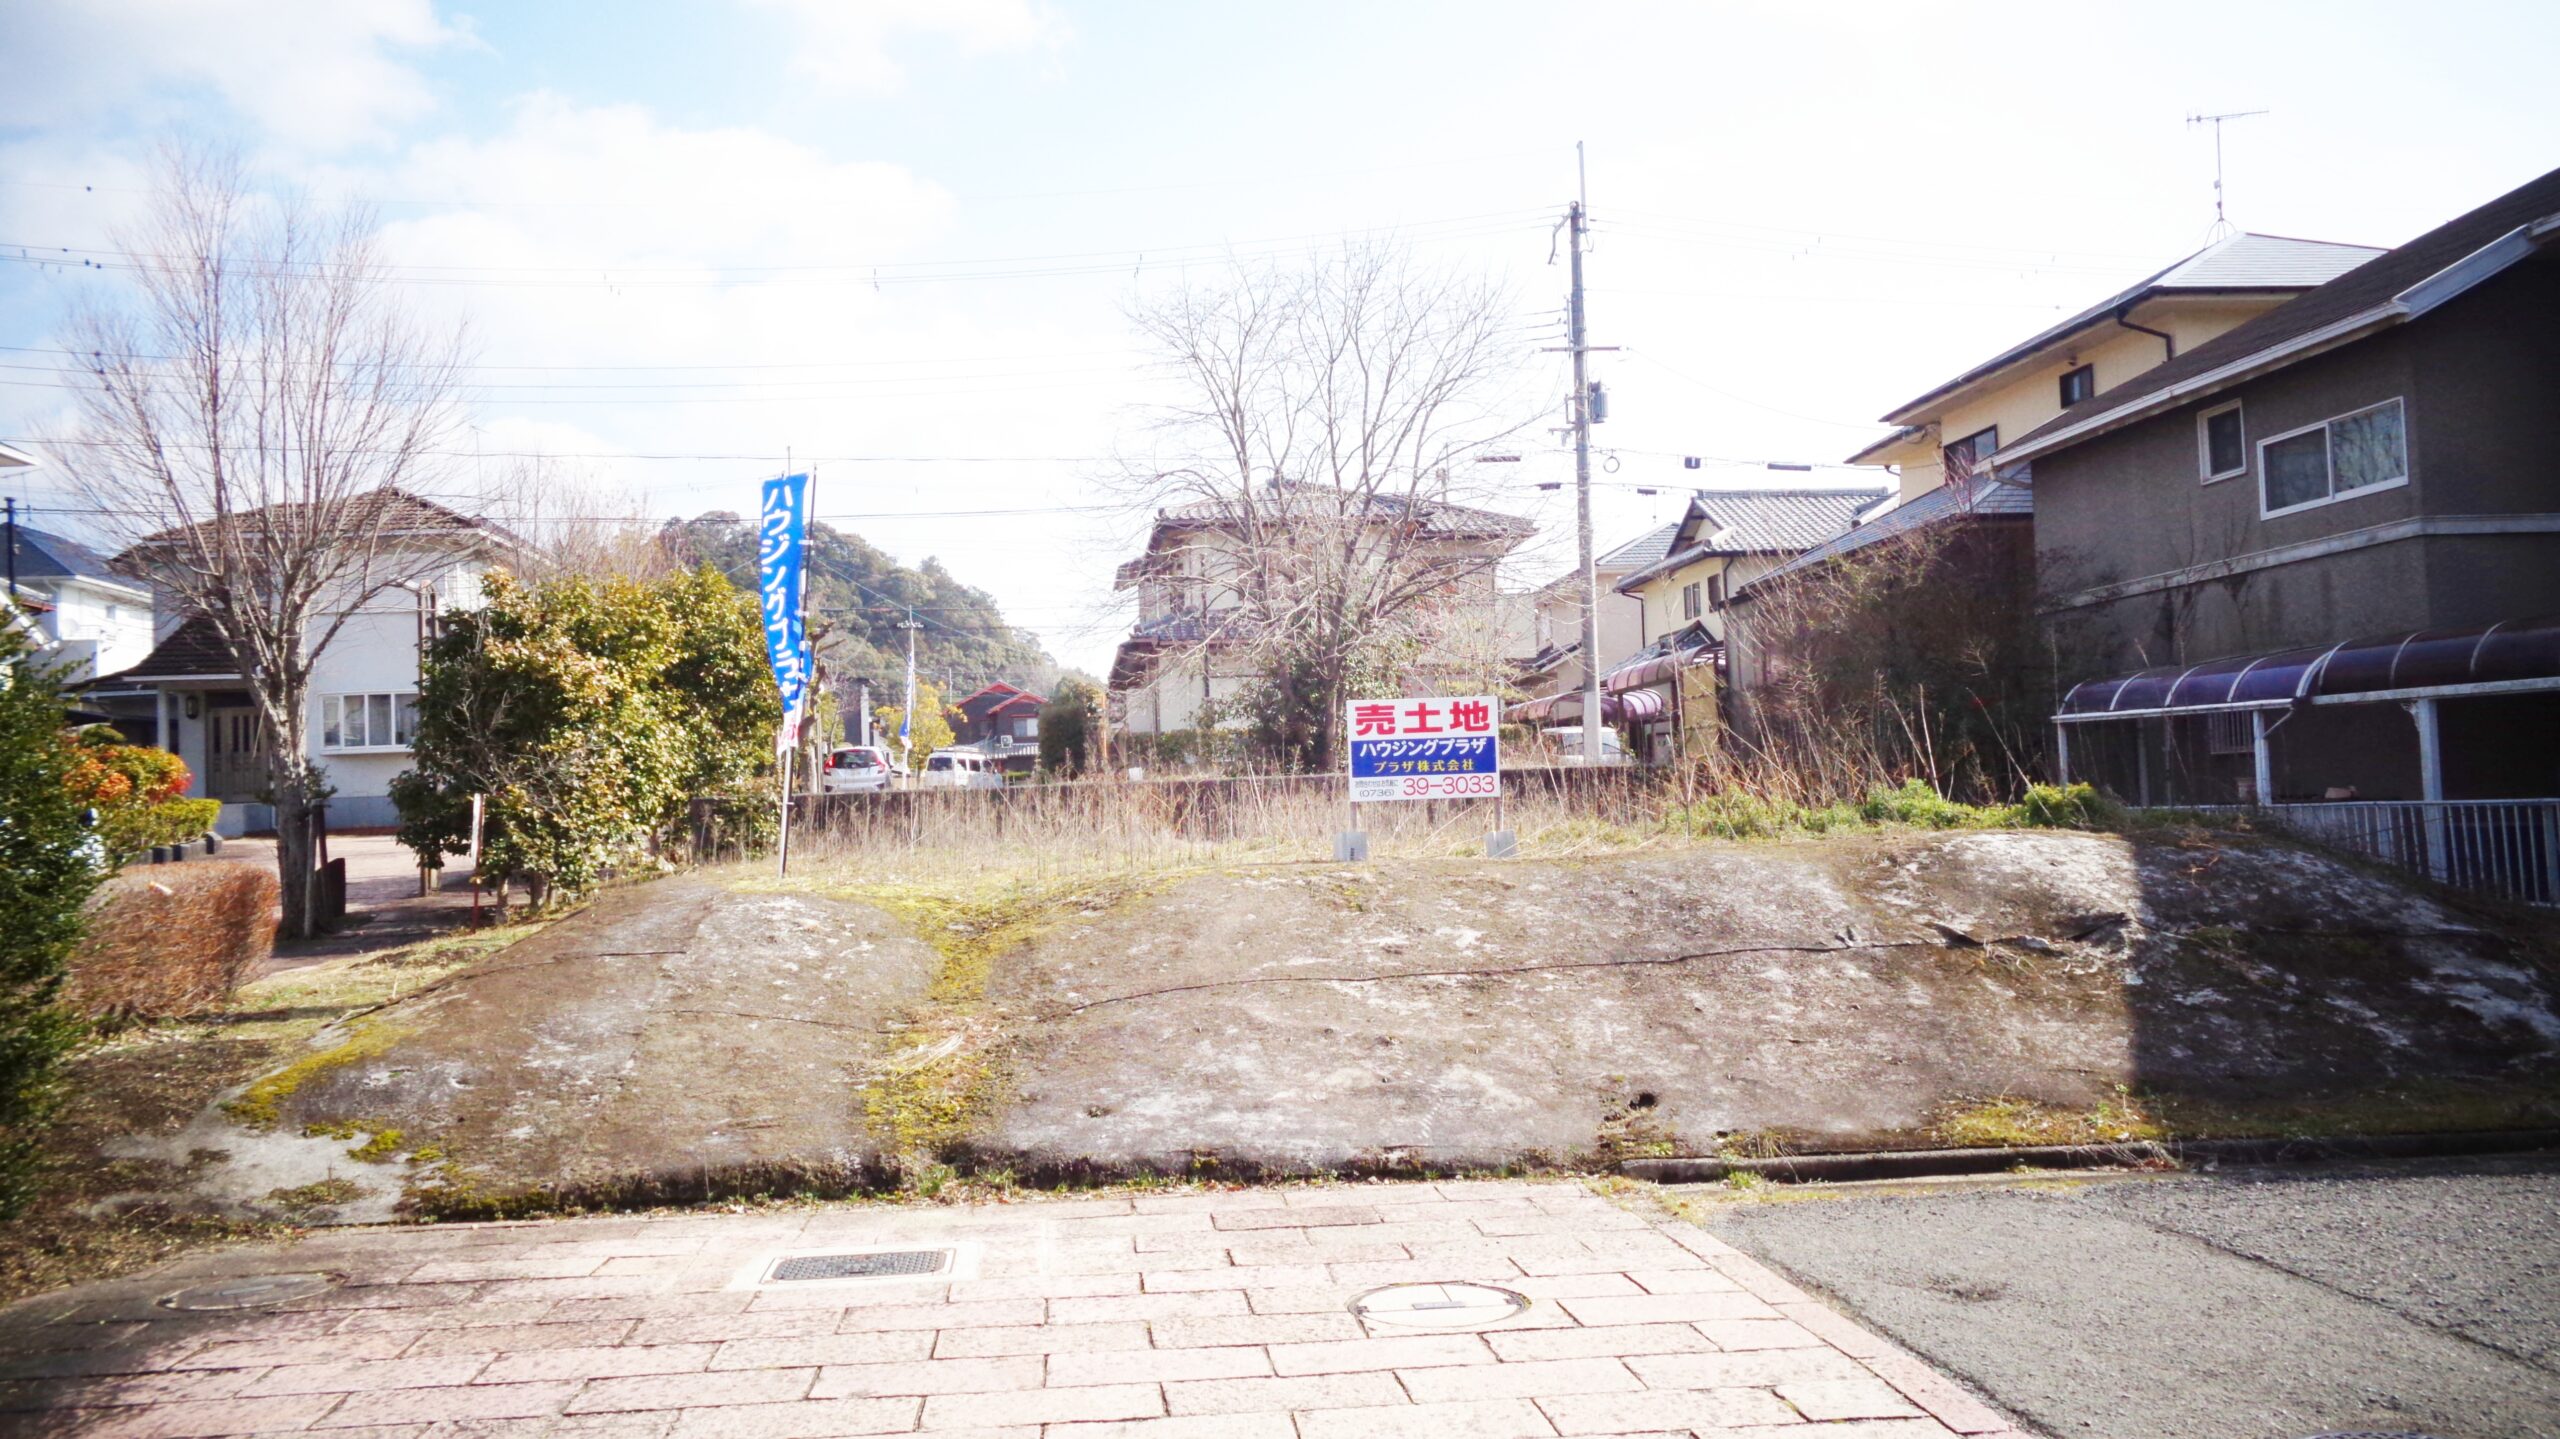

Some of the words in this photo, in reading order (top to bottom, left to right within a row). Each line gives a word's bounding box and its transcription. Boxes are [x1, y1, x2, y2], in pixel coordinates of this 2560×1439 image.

[1354, 700, 1490, 736] 売土地
[1359, 737, 1487, 757] ハウジングプラザ
[1374, 758, 1474, 774] プラザ株式会社
[1359, 789, 1395, 798] (0736)
[1403, 775, 1495, 796] 39-3033
